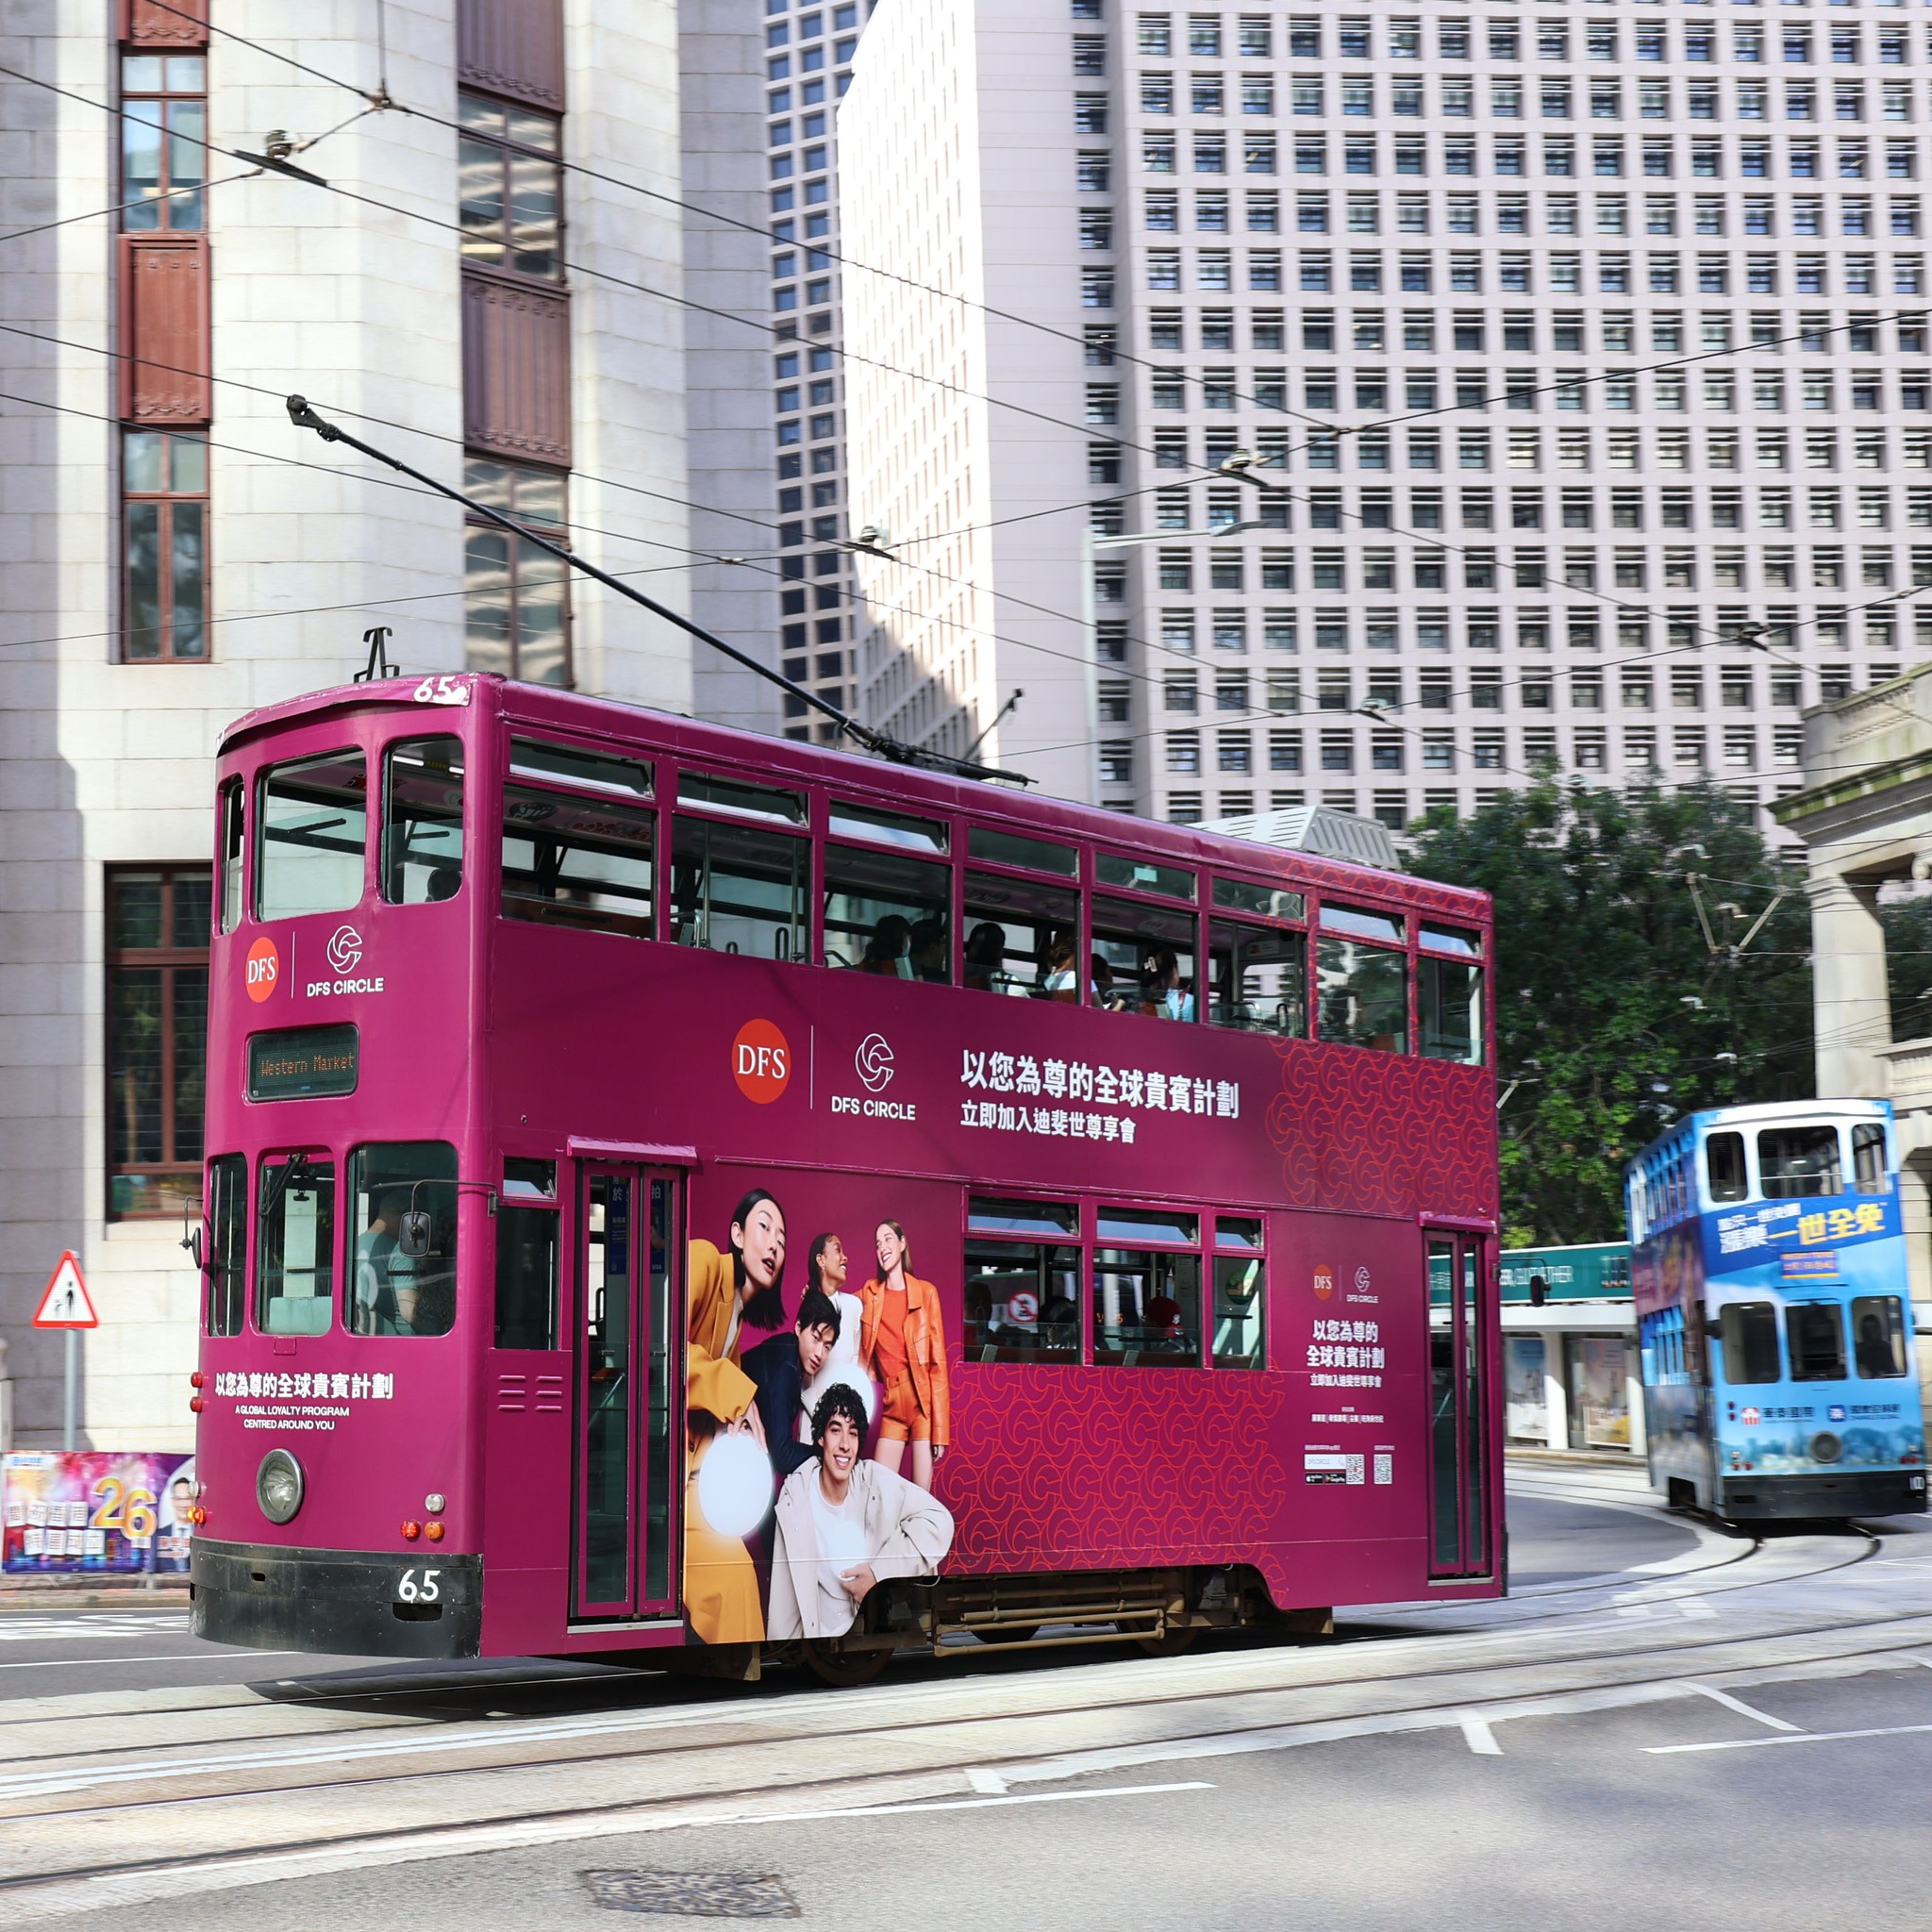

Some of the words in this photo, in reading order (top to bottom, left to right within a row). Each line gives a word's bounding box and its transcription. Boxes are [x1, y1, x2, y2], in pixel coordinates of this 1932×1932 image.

[414, 675, 455, 704] 65
[247, 960, 276, 985] DFS
[308, 978, 330, 997] DFS
[333, 976, 384, 995] CIRCLE
[260, 1058, 308, 1076] Western
[313, 1052, 355, 1072] Market
[738, 1043, 785, 1080] DFS
[960, 1049, 1240, 1121] 以您為尊的全球貴賓計劃
[831, 1095, 860, 1115] DFS
[863, 1098, 916, 1121] CIRCLE
[960, 1099, 1137, 1144] 立即加入迪斐世尊享會
[1313, 1275, 1332, 1290] DFS
[1312, 1319, 1378, 1343] 以您為尊的
[1306, 1345, 1385, 1369] 全球貴賓計劃
[215, 1371, 394, 1400] 以您為尊的全球貴賓計劃
[235, 1405, 241, 1415] A
[241, 1405, 268, 1416] GLOBAL
[268, 1405, 302, 1416] LOYALTY
[302, 1406, 350, 1417] PROGRAM
[243, 1418, 277, 1429] CENTRED
[277, 1419, 314, 1430] AROUND
[314, 1420, 335, 1430] YOU
[90, 1475, 158, 1541] 26
[398, 1569, 441, 1602] 65
